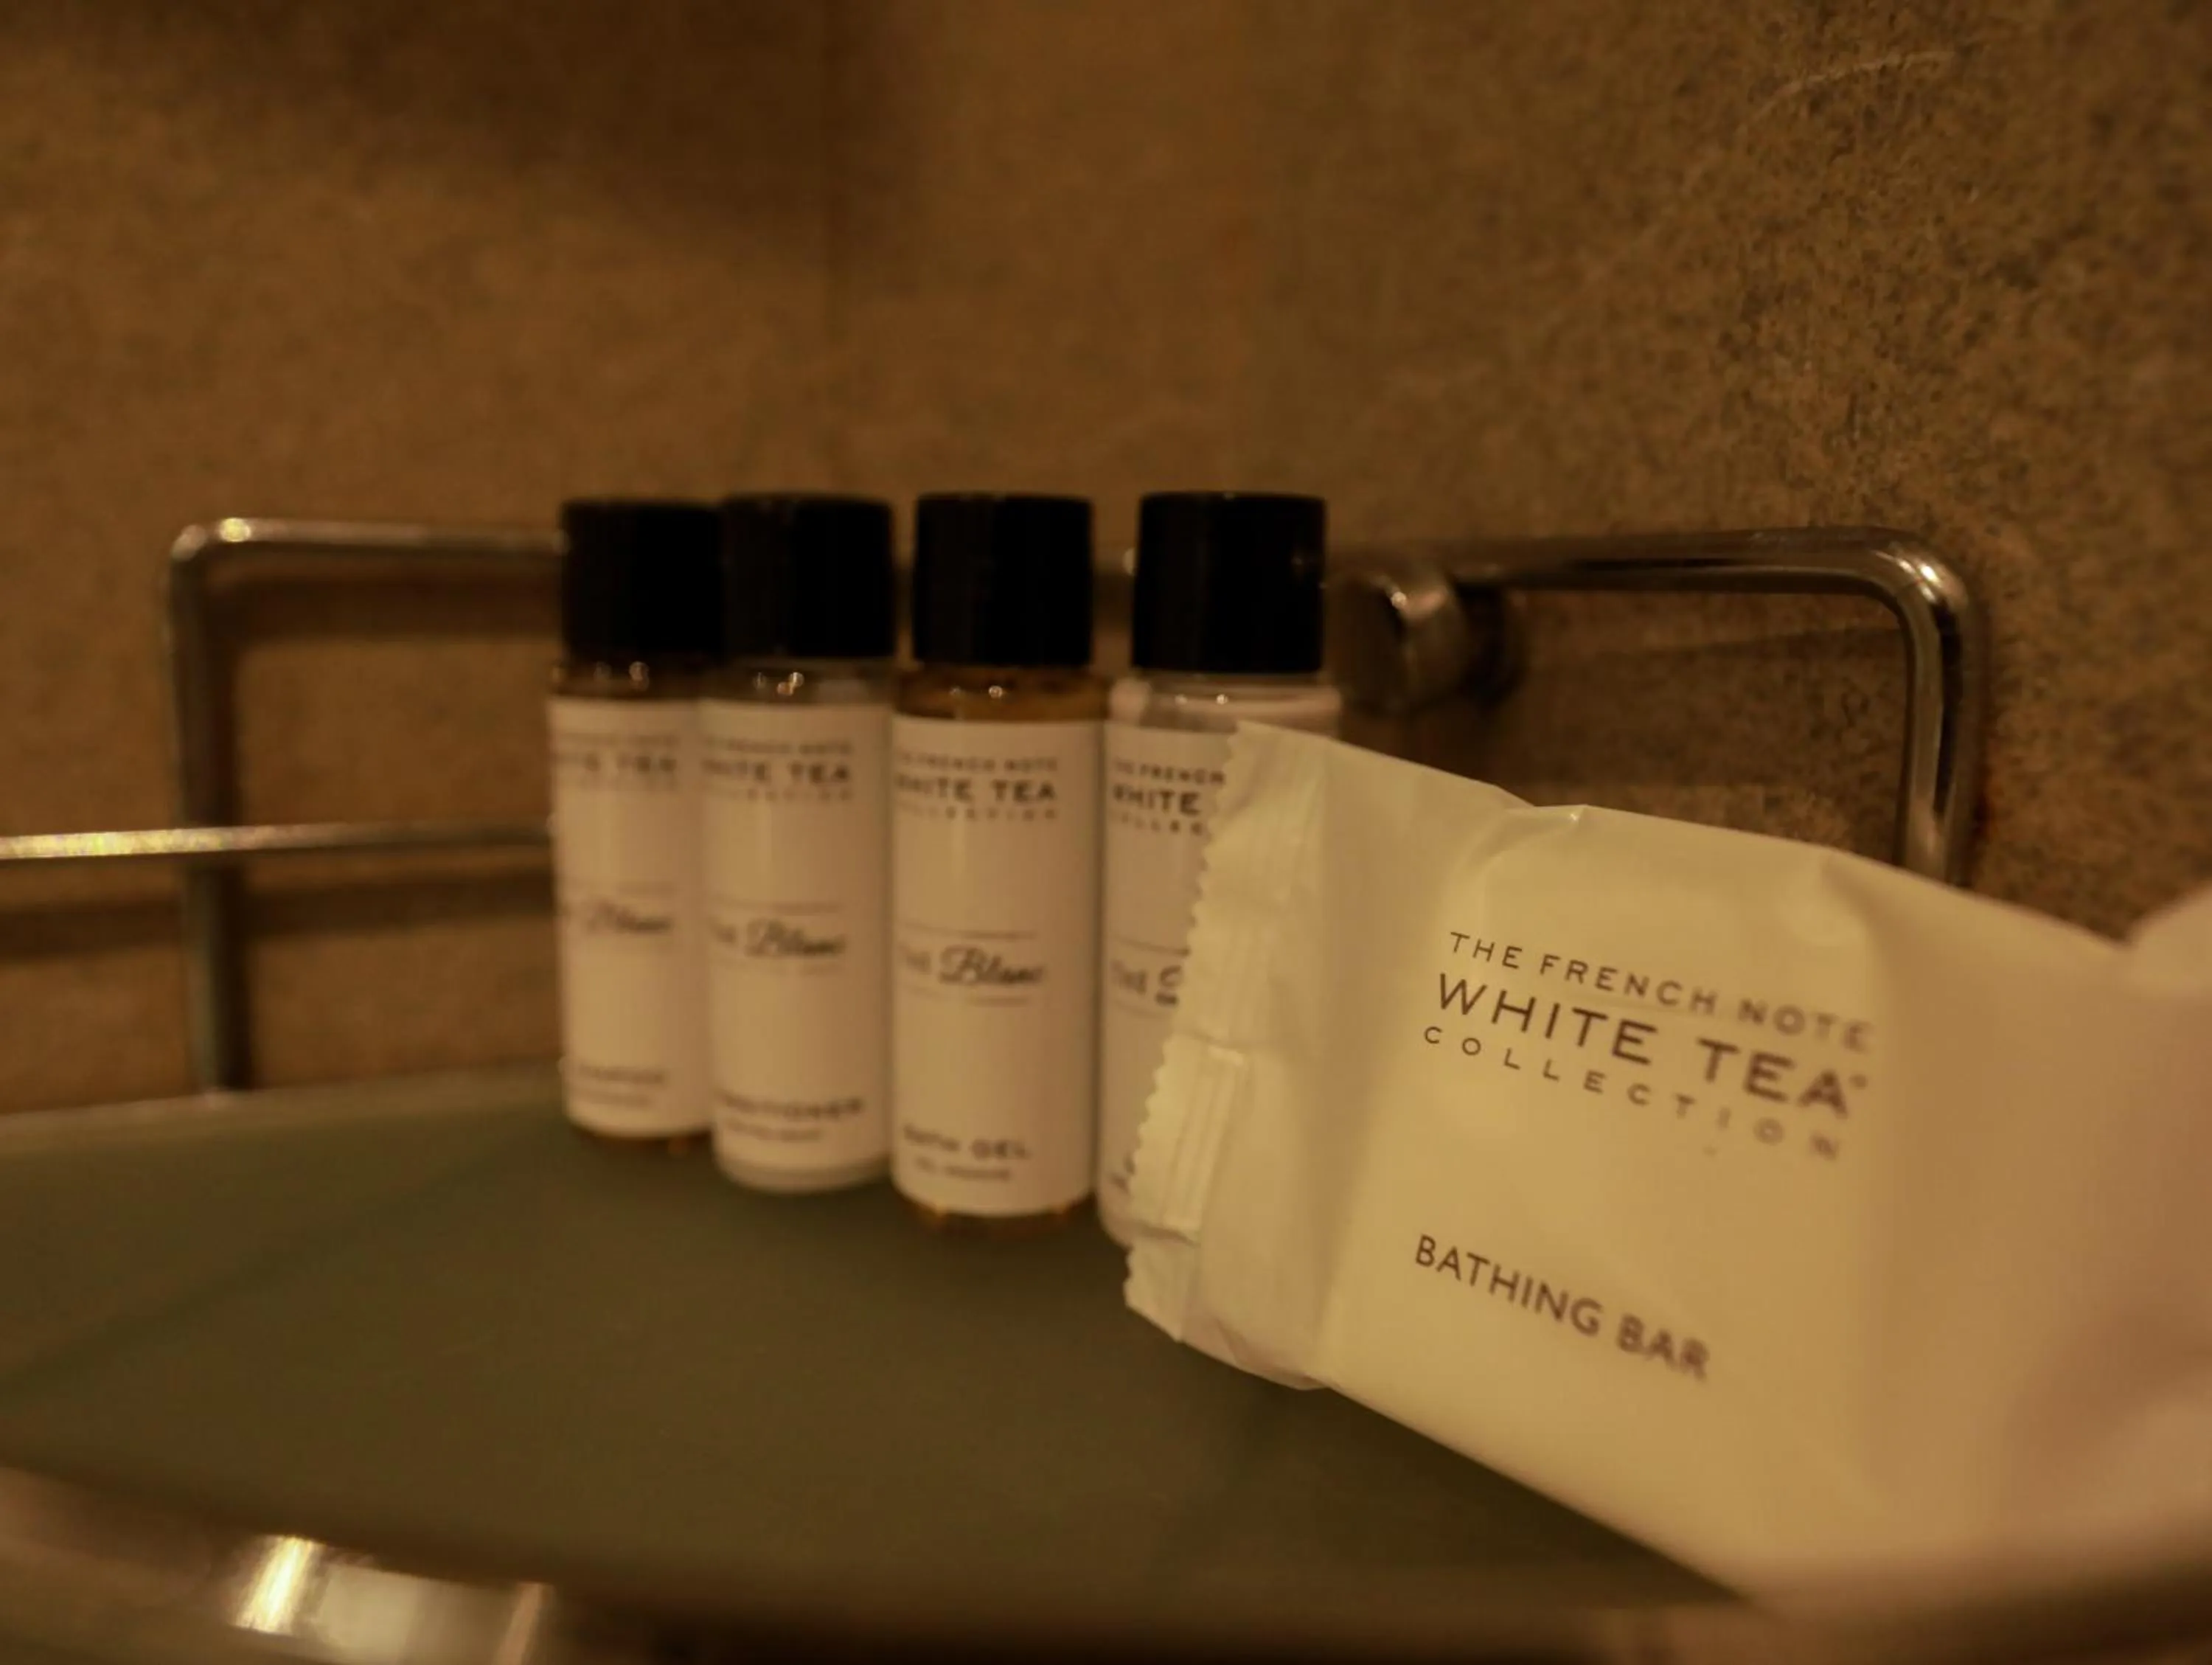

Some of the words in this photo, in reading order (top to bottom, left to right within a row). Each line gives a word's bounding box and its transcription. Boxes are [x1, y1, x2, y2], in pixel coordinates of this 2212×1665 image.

[990, 778, 1058, 804] TEA
[1439, 972, 1659, 1066] WHITE
[1449, 931, 1523, 970] THE
[1539, 953, 1718, 1017] FRENCH
[1737, 998, 1871, 1054] NOTE
[1422, 1025, 1841, 1162] COLLECTION
[1414, 1233, 1604, 1338] BATHING
[1615, 1312, 1711, 1383] BAR
